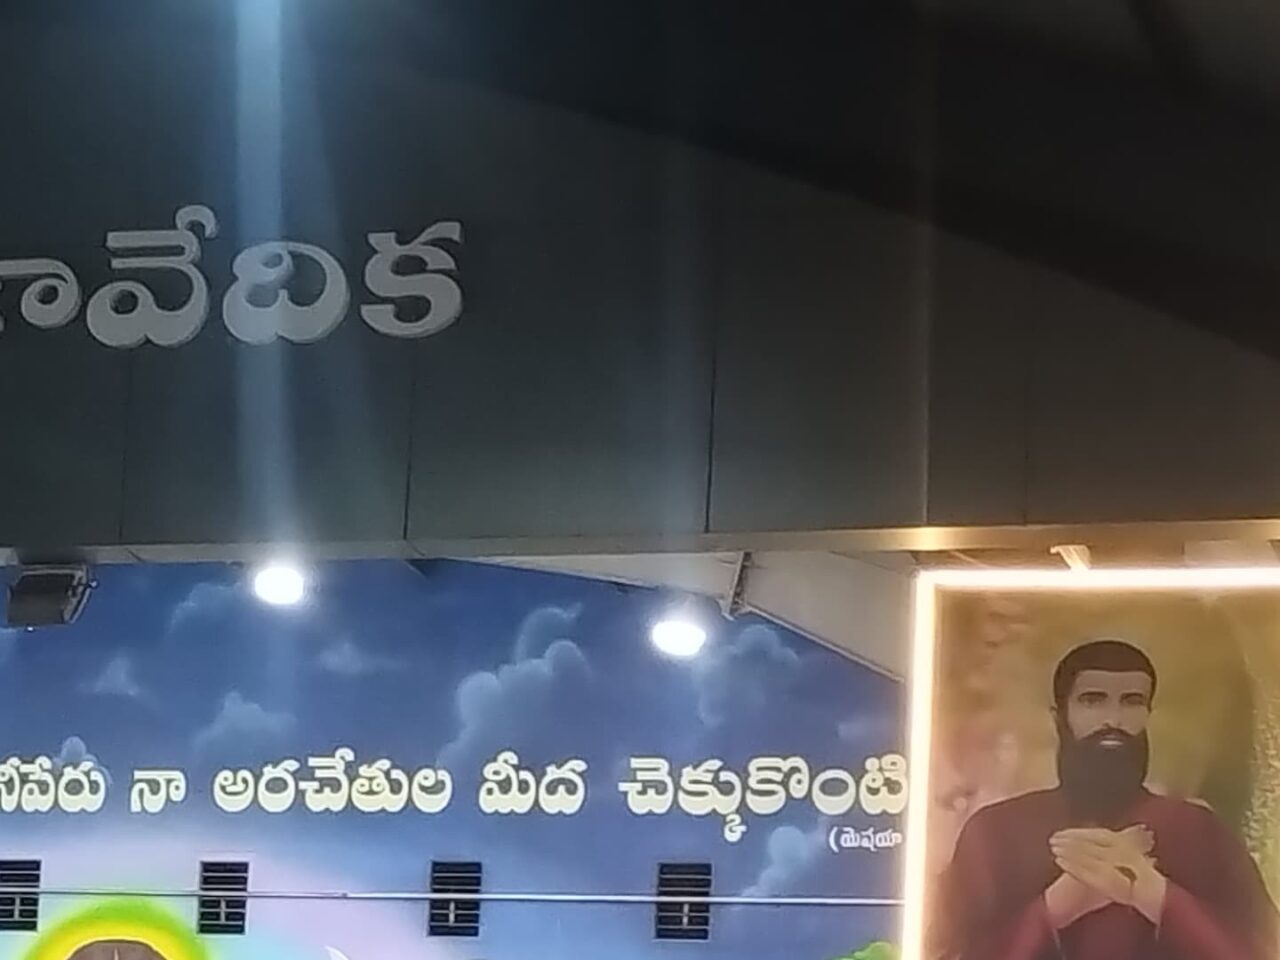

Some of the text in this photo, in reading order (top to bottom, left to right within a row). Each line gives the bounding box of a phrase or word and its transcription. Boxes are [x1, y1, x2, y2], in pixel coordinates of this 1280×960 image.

[130, 770, 186, 813] నా
[213, 747, 453, 813] అరచేతుల
[479, 751, 588, 814] మీద
